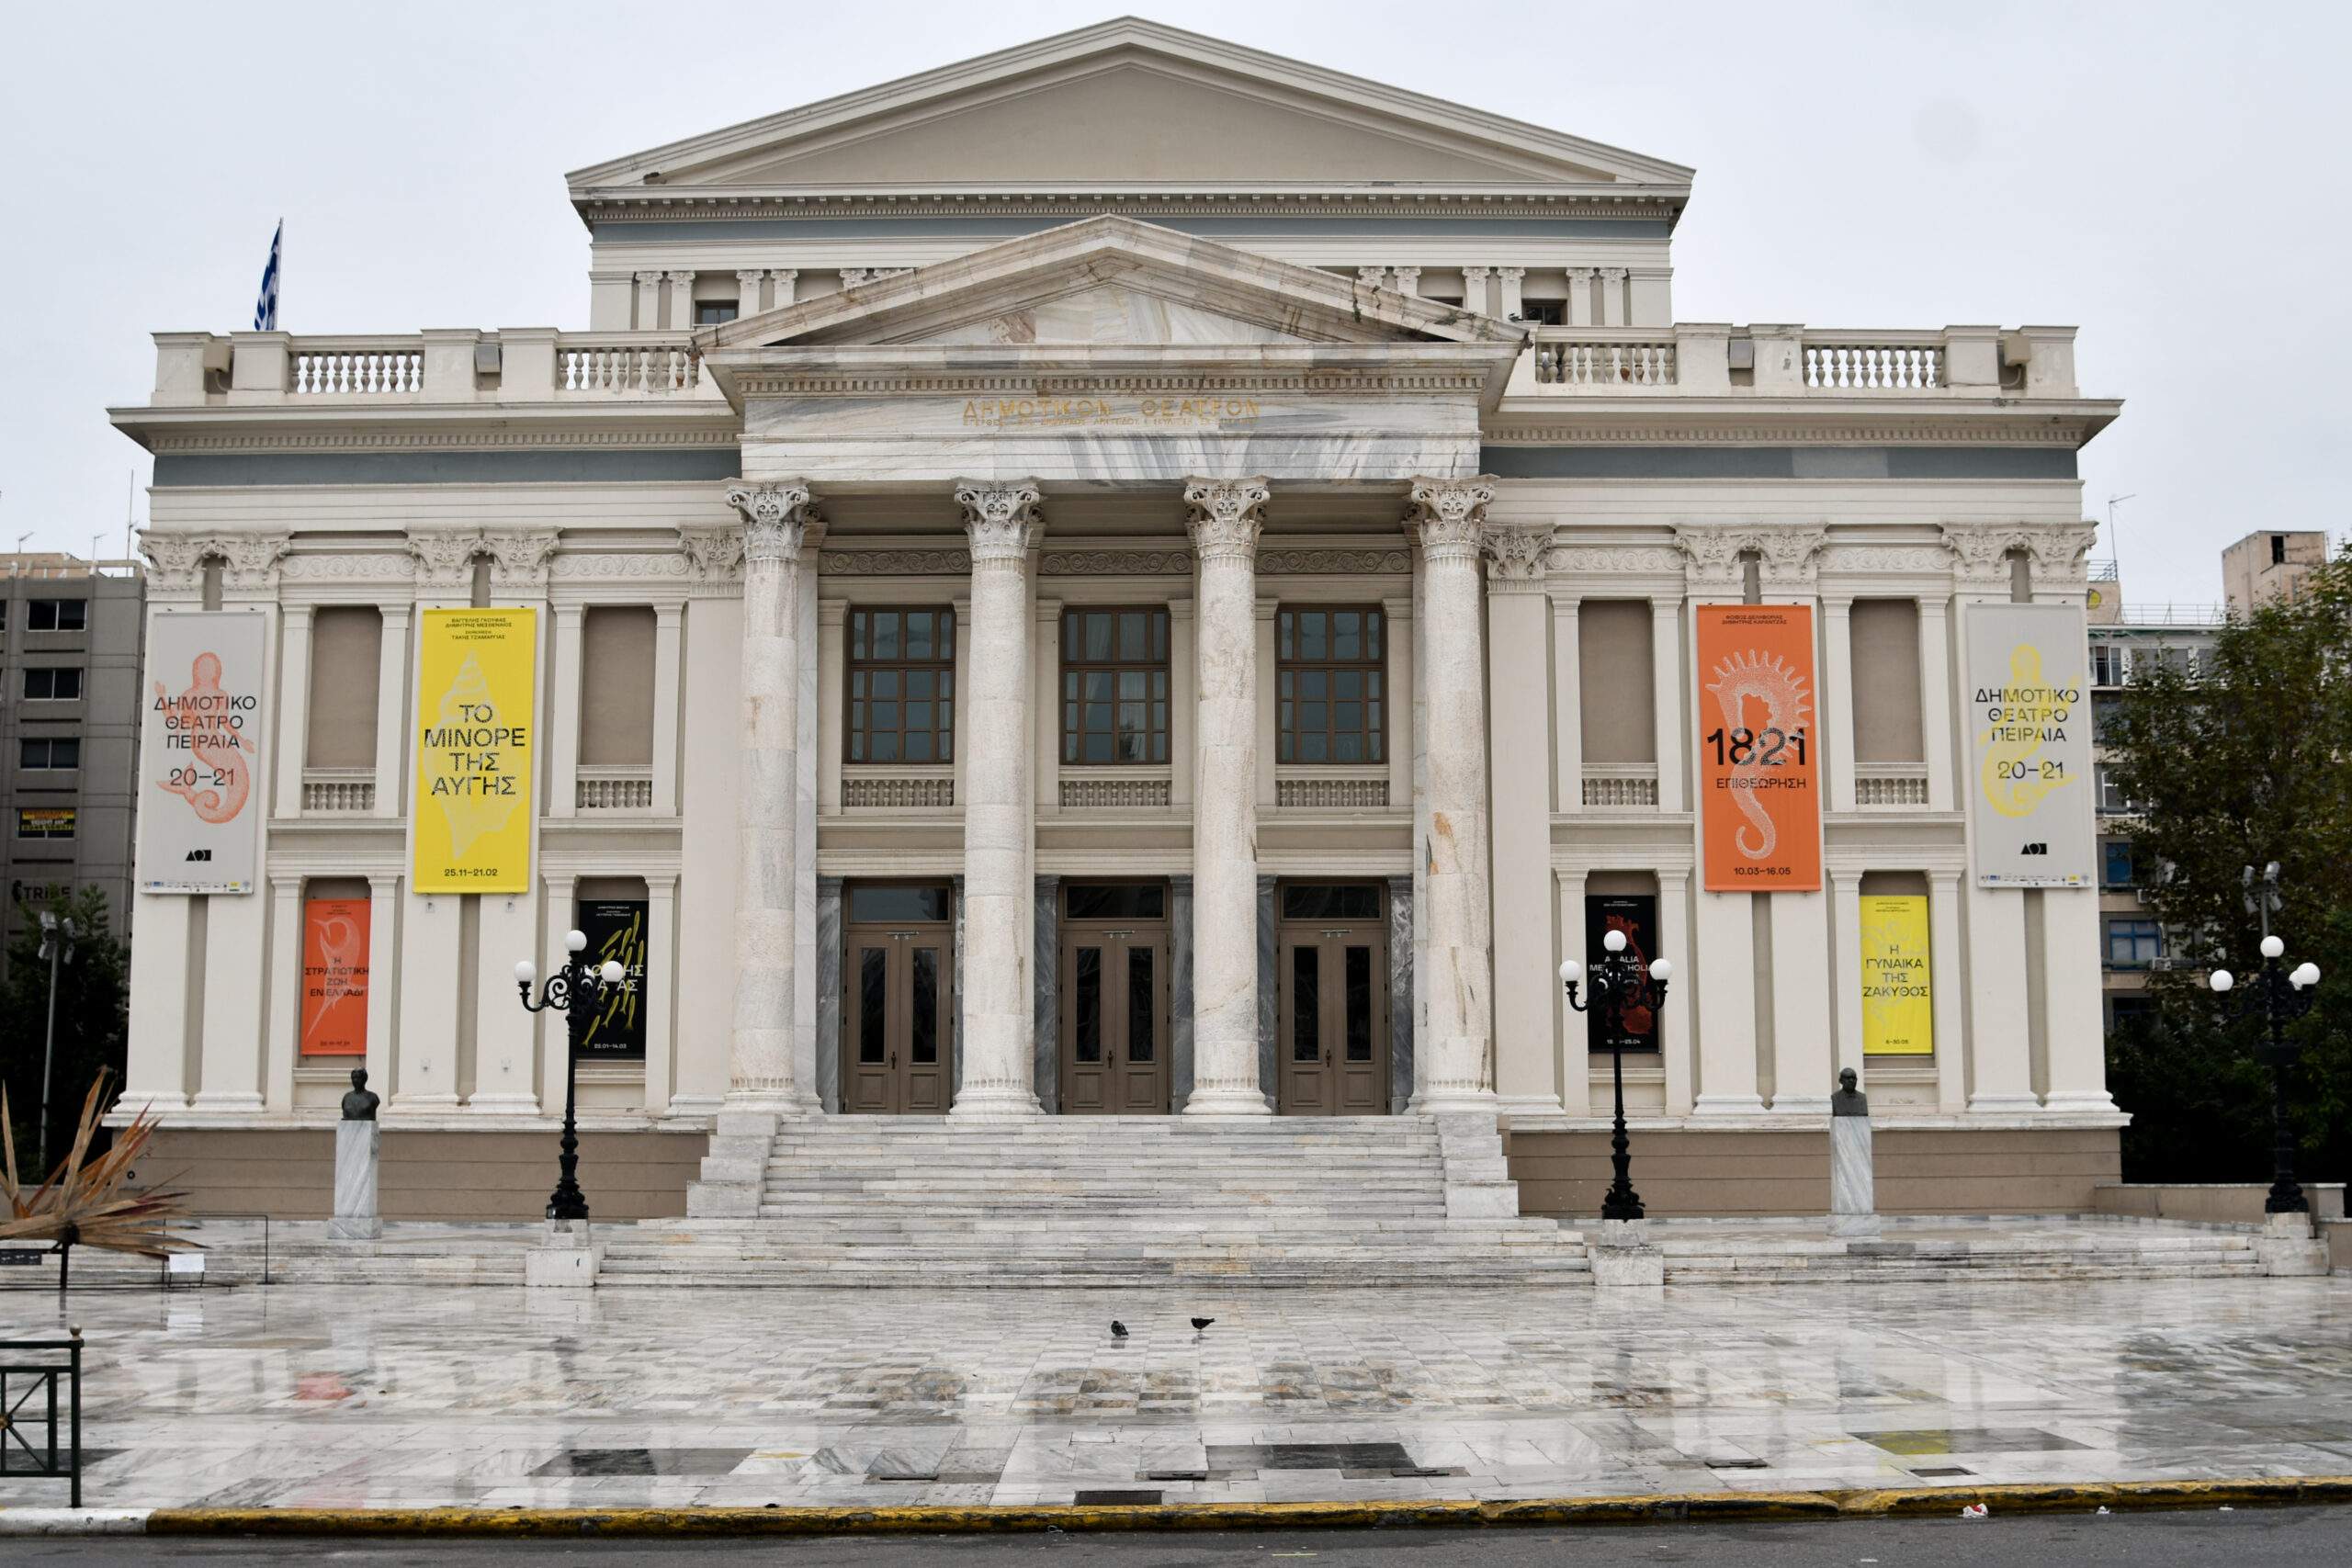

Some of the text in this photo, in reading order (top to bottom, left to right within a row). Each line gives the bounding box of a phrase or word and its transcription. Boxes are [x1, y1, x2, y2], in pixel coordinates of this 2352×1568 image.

[963, 399, 1259, 418] ΔΗΜΟΤΙΚΟΝ ΘΕΑΤΡΟΝ
[153, 695, 256, 711] ΔΗΜΟΤΙΚΟ
[1975, 688, 2079, 704] ΔΗΜΟΤΙΚΟ
[459, 705, 493, 724] ΤΟ
[1988, 707, 2068, 723] ΘΕΑΤΡΟ
[165, 715, 243, 729] ΘΕΑΤΡΟ
[167, 735, 240, 749] ΠΕΙΡΑΙΑ
[424, 728, 526, 748] ΜΙΝΟΡΕ
[1992, 728, 2066, 742] ΠΕΙΡΑΙΑ
[1707, 728, 1805, 766] 1821
[449, 752, 501, 772] ΤΗΣ
[431, 776, 516, 795] ΑΥΓΗΣ
[1716, 778, 1806, 789] ΕΠΙΘΕΩΡΗΣΗ
[1890, 944, 1899, 954] Η
[1866, 958, 1924, 969] ΓΥΝΑΙΚΑ
[305, 966, 368, 976] ΣΤΡΑΤΙΩΤΙΚΗ
[1882, 972, 1908, 983] ΤΗΣ
[310, 988, 363, 997] ΕΝ ΕΛΛΑΔΙ
[1863, 987, 1928, 997] ΖΑΚΥΘΟΣ
